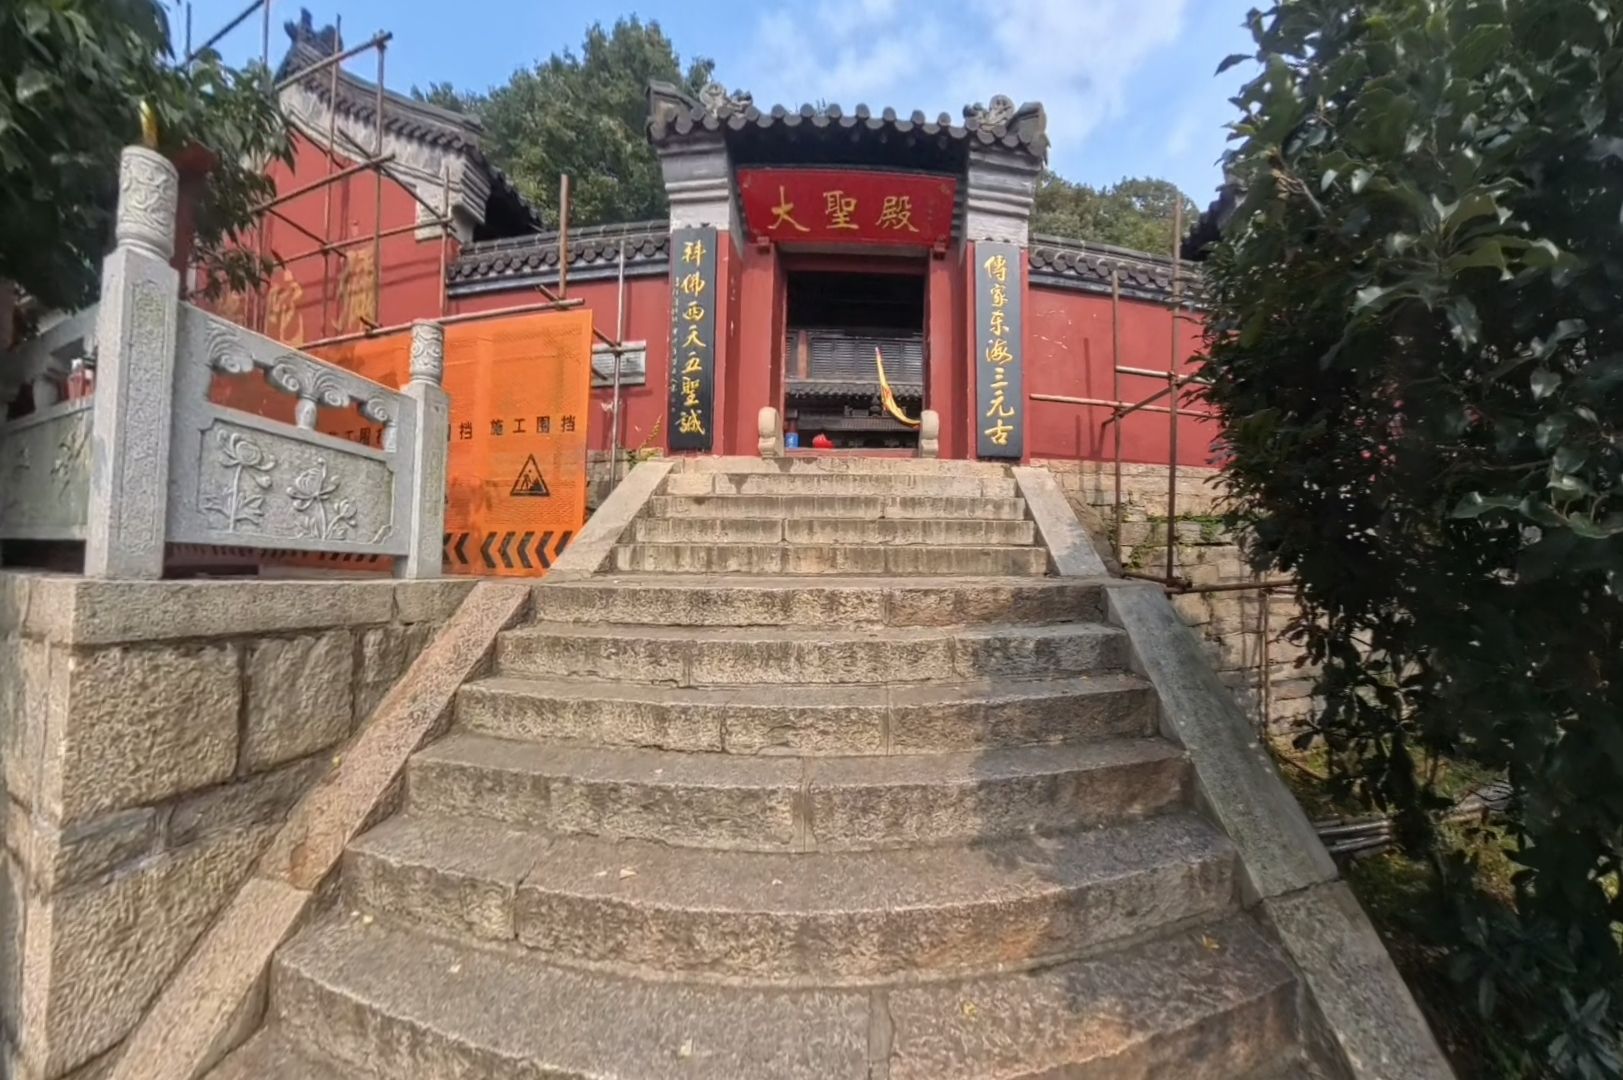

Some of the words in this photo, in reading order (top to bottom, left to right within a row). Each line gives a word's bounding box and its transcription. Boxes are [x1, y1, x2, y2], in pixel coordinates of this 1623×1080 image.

[767, 185, 919, 232] 大聖殿
[490, 415, 576, 436] 施工围挡
